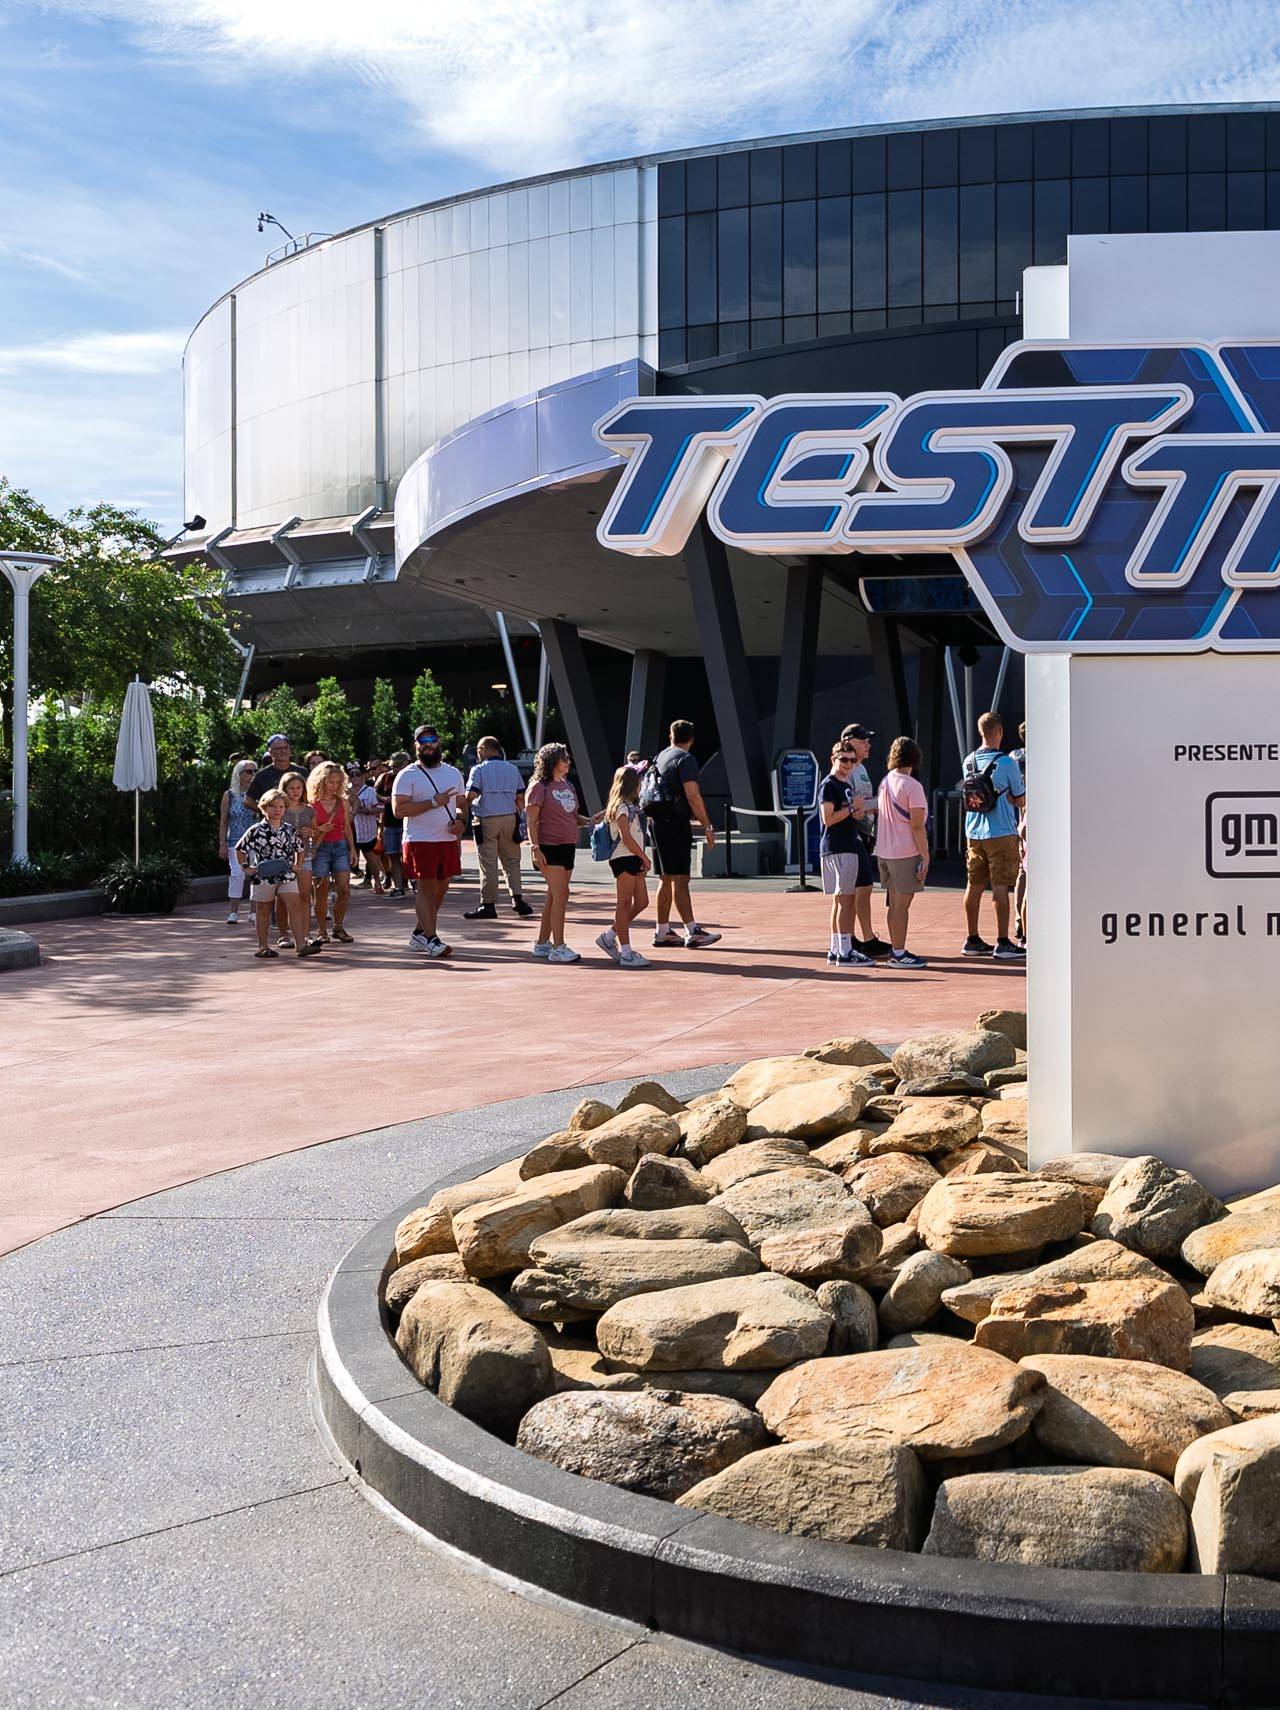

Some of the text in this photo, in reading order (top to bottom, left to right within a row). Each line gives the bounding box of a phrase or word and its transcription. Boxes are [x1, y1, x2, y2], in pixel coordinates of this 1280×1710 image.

[592, 384, 1194, 553] TEST
[1220, 813, 1278, 857] gm
[1101, 905, 1247, 944] general
